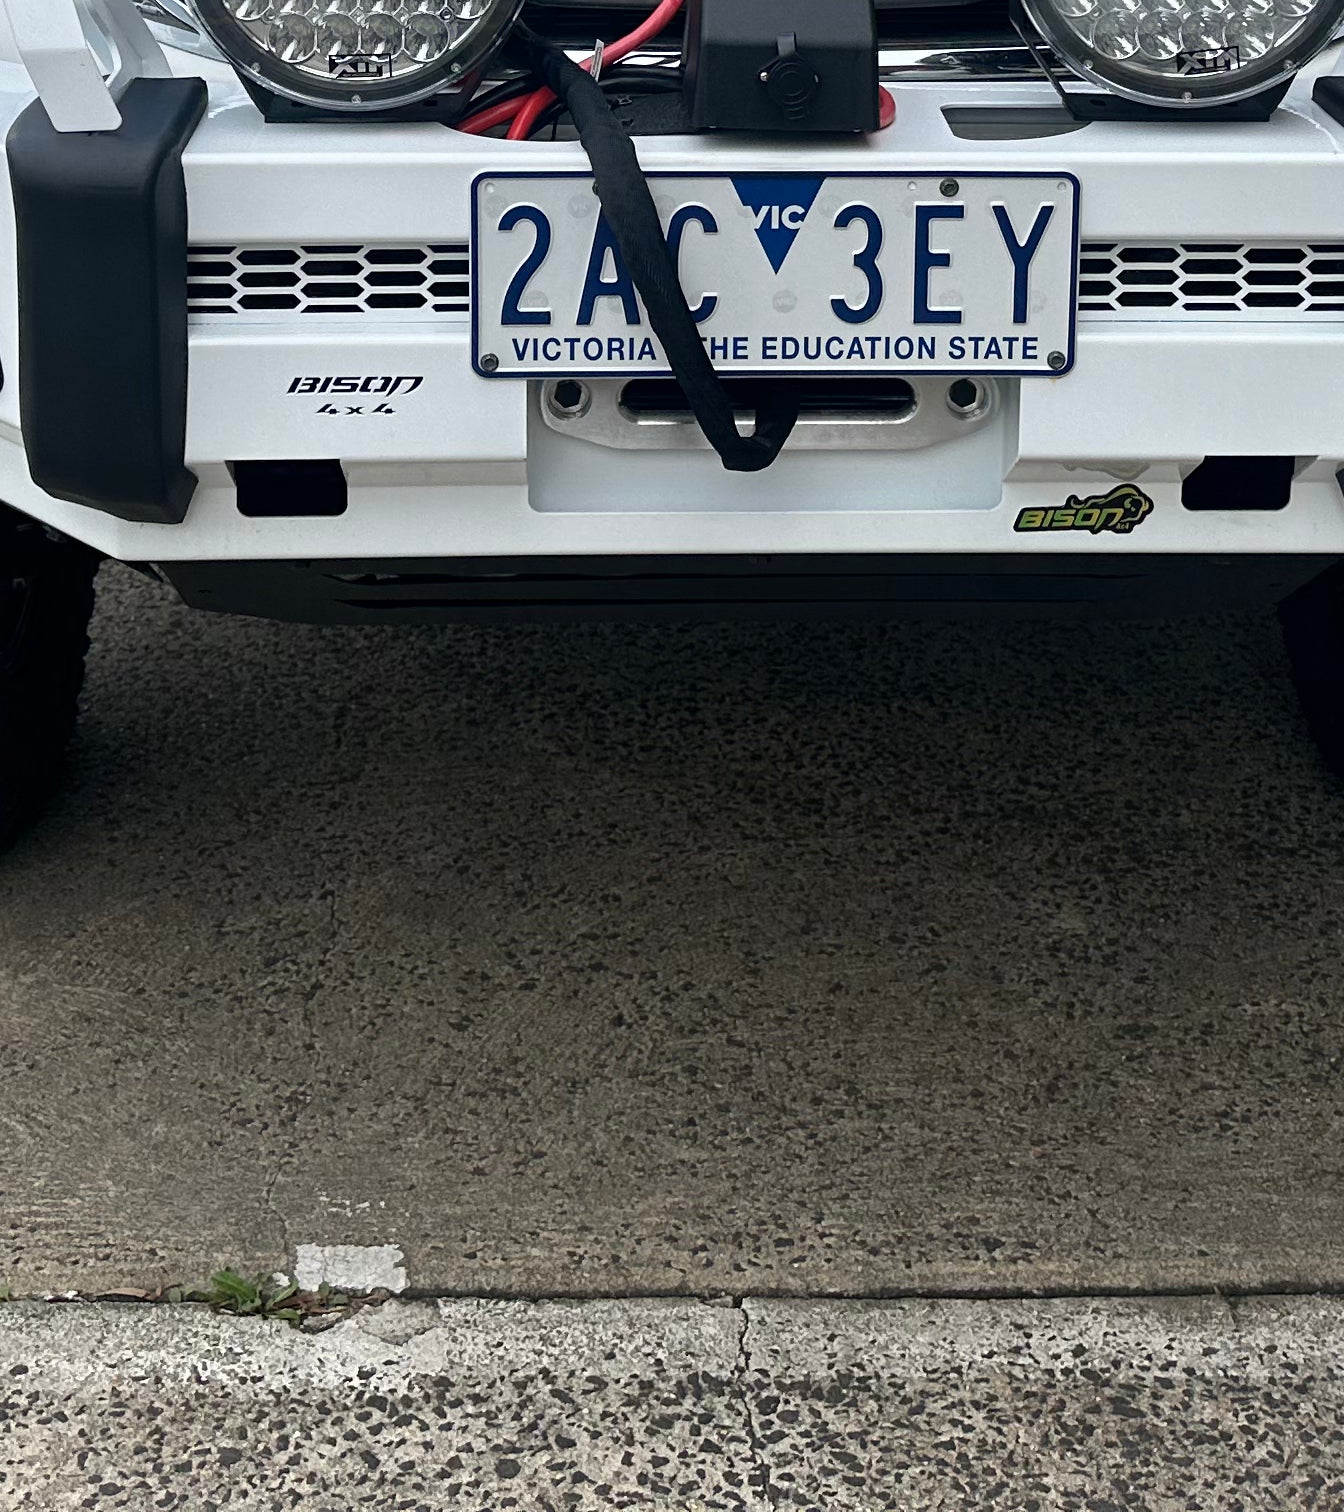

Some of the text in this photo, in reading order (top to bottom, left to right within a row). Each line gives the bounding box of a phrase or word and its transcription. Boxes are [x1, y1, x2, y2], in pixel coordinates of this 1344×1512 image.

[746, 204, 806, 230] VIC
[497, 204, 1056, 326] 2AC 3EY
[511, 336, 657, 362] VICTORIA
[762, 335, 936, 361] EDUCATION
[947, 335, 1039, 361] STATE
[285, 375, 424, 397] BISON
[1018, 507, 1125, 531] BISON
